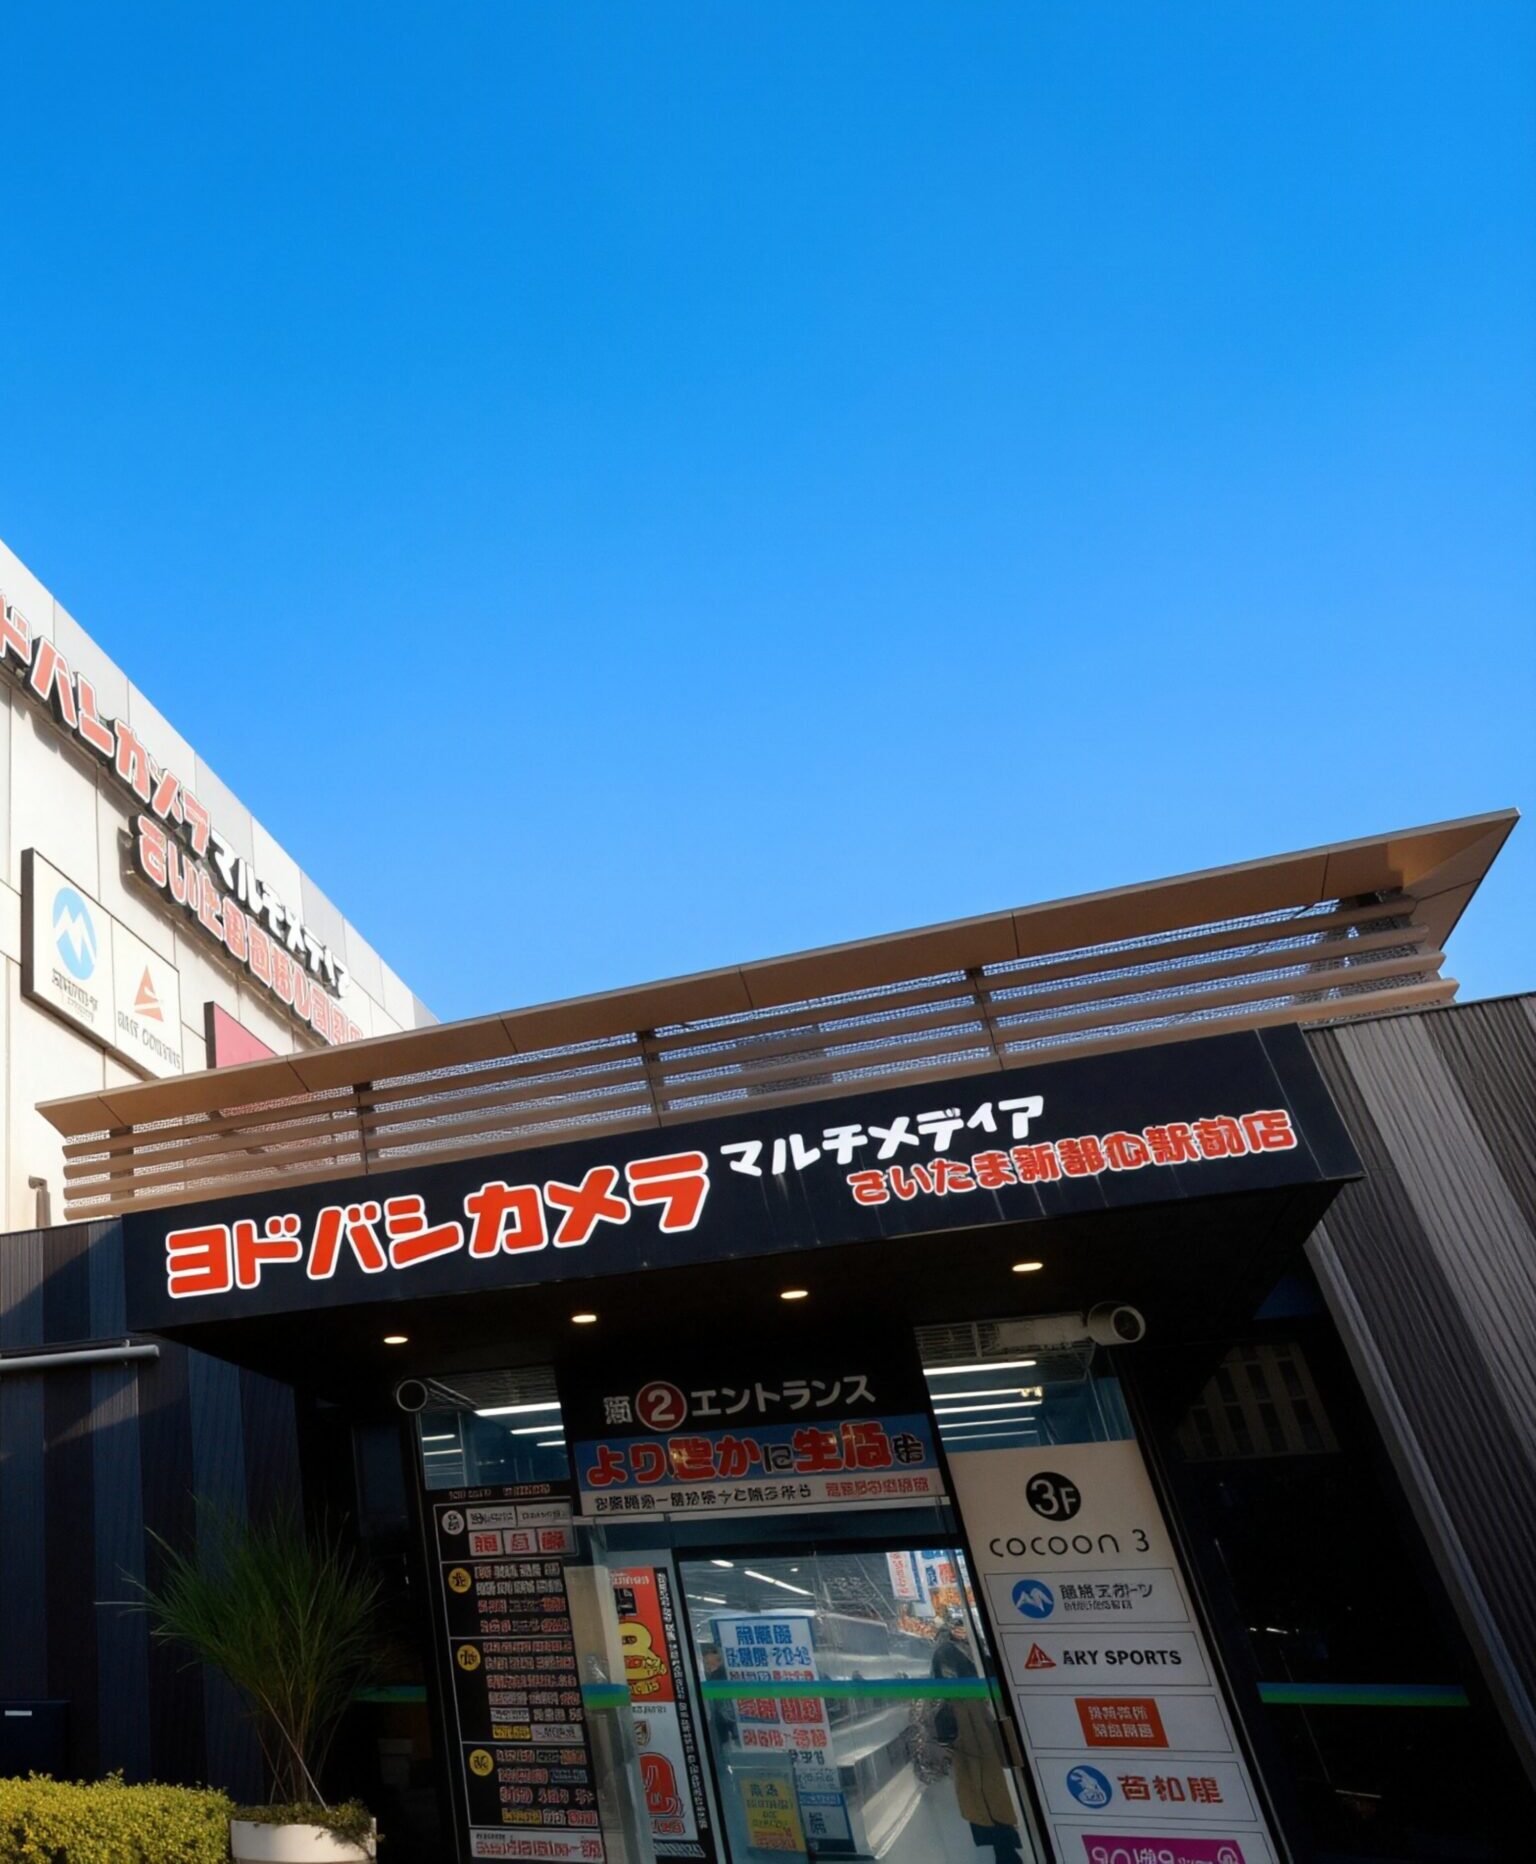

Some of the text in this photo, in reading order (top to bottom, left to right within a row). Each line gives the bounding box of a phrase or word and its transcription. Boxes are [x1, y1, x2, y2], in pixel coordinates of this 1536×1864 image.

[719, 1094, 1045, 1178] マルチメディア
[165, 1150, 711, 1299] ヨドバシカメラ
[989, 1528, 1151, 1558] cocoon 3
[1105, 1650, 1183, 1665] SPORTS
